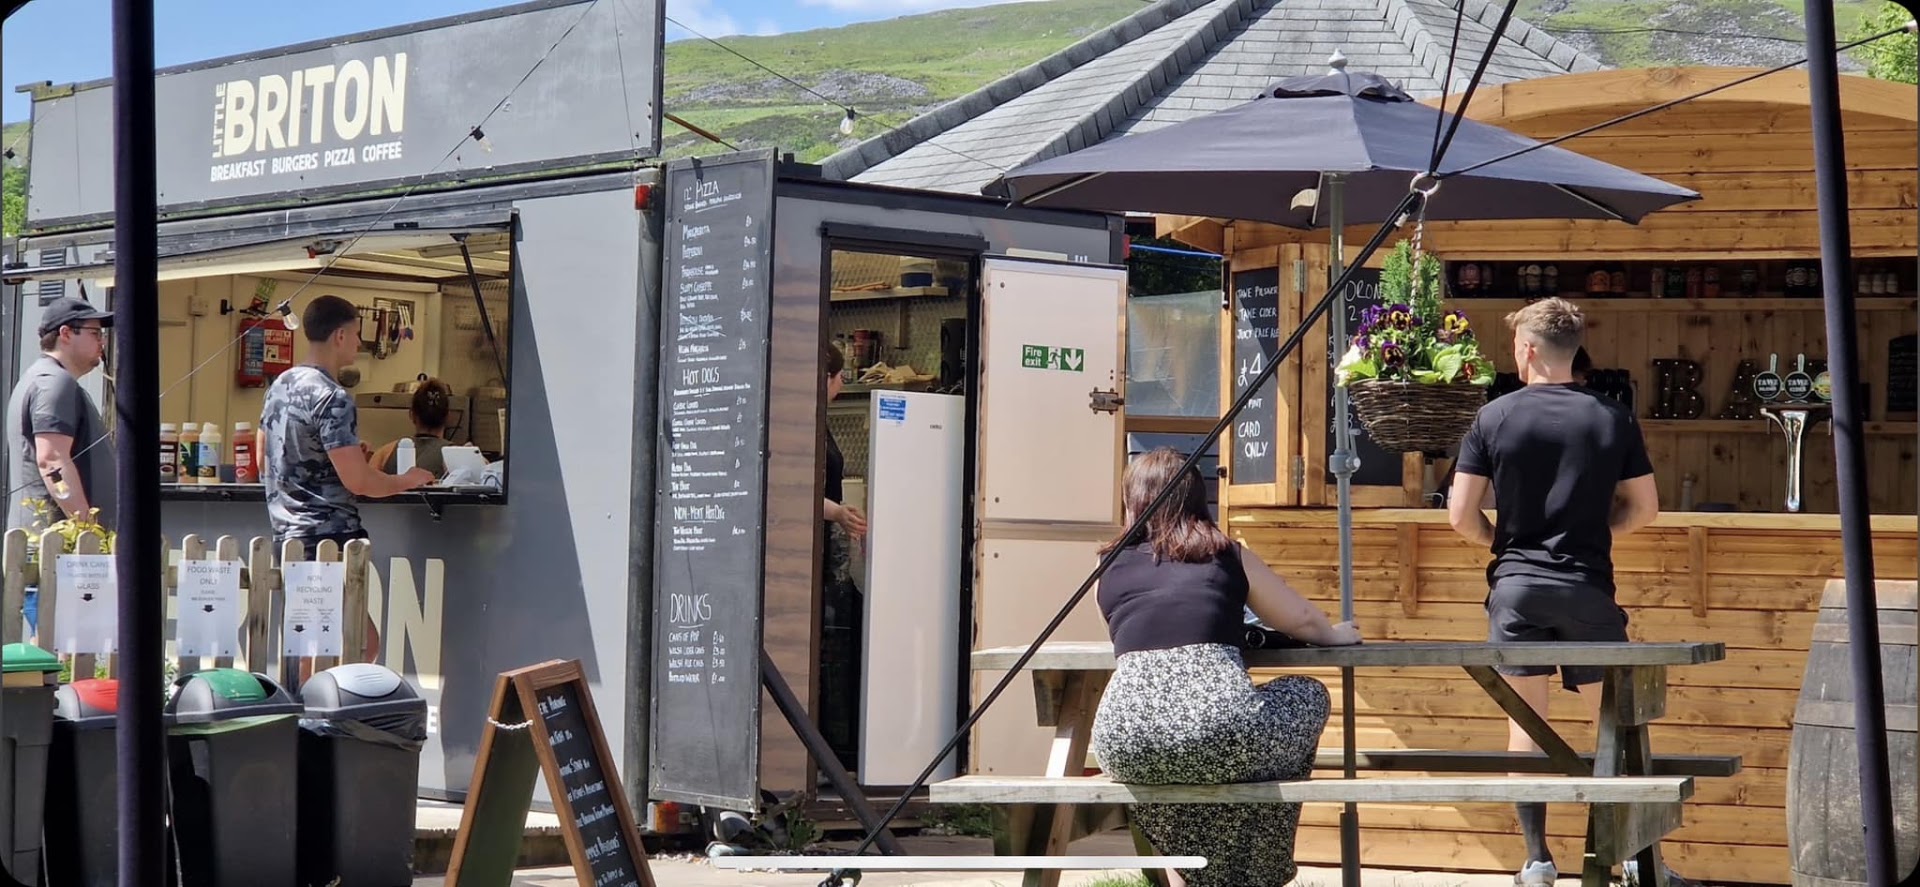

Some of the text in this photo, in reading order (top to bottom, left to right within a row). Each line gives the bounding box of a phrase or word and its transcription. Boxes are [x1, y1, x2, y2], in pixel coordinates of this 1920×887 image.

[223, 52, 408, 156] BRITON
[212, 82, 226, 158] LITTLE
[210, 141, 403, 182] BREAKFAST BURGERS PIZZA COFFEE
[695, 179, 719, 200] PIZZA
[1025, 346, 1042, 357] Fire
[1025, 357, 1042, 367] exit
[682, 366, 720, 386] HOT DOGS
[1238, 420, 1261, 438] CARD
[1244, 441, 1269, 459] ONLY
[187, 566, 207, 574] FOOD
[670, 593, 712, 624] DRINKS
